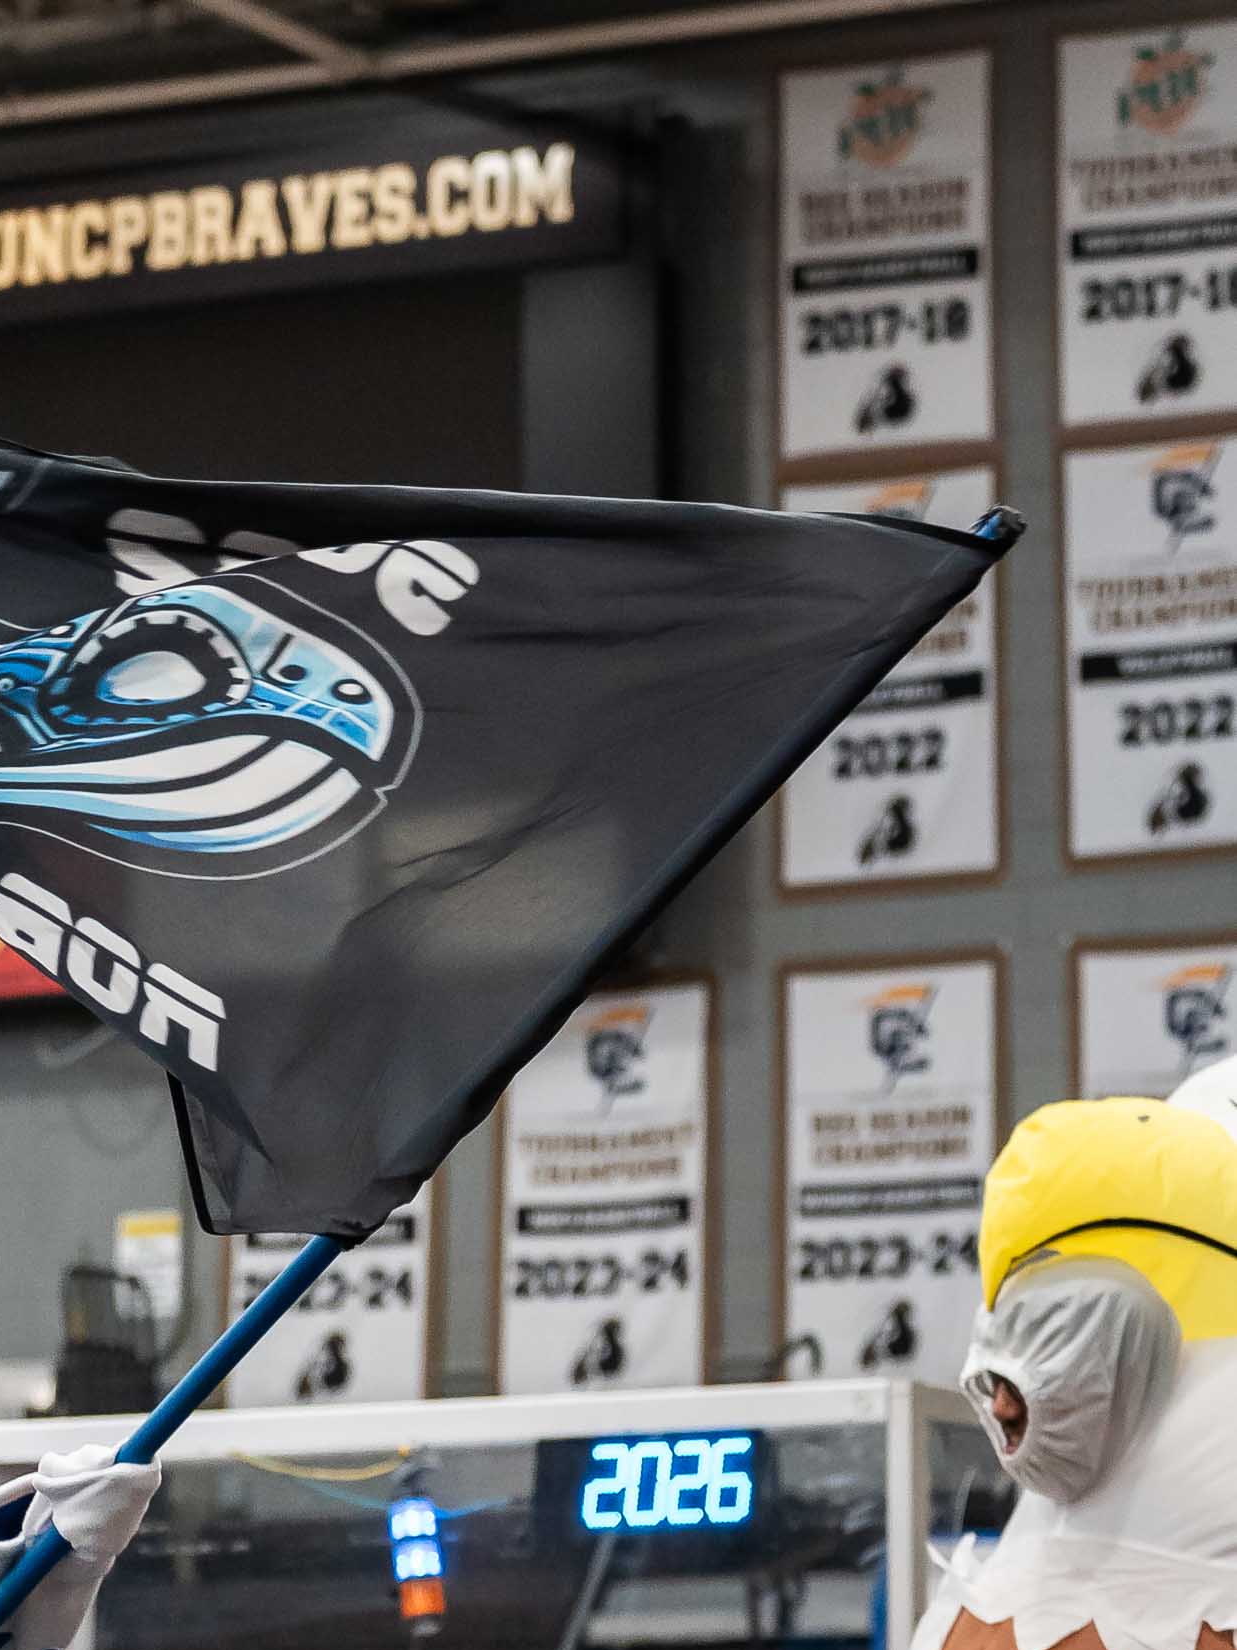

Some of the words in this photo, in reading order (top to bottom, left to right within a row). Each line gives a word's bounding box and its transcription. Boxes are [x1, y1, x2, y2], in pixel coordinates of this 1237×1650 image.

[832, 727, 945, 781] 2022
[515, 1249, 689, 1299] 2023-24
[798, 1232, 982, 1282] 2023-24
[242, 1268, 413, 1312] 223-24
[582, 1436, 752, 1530] 2026
